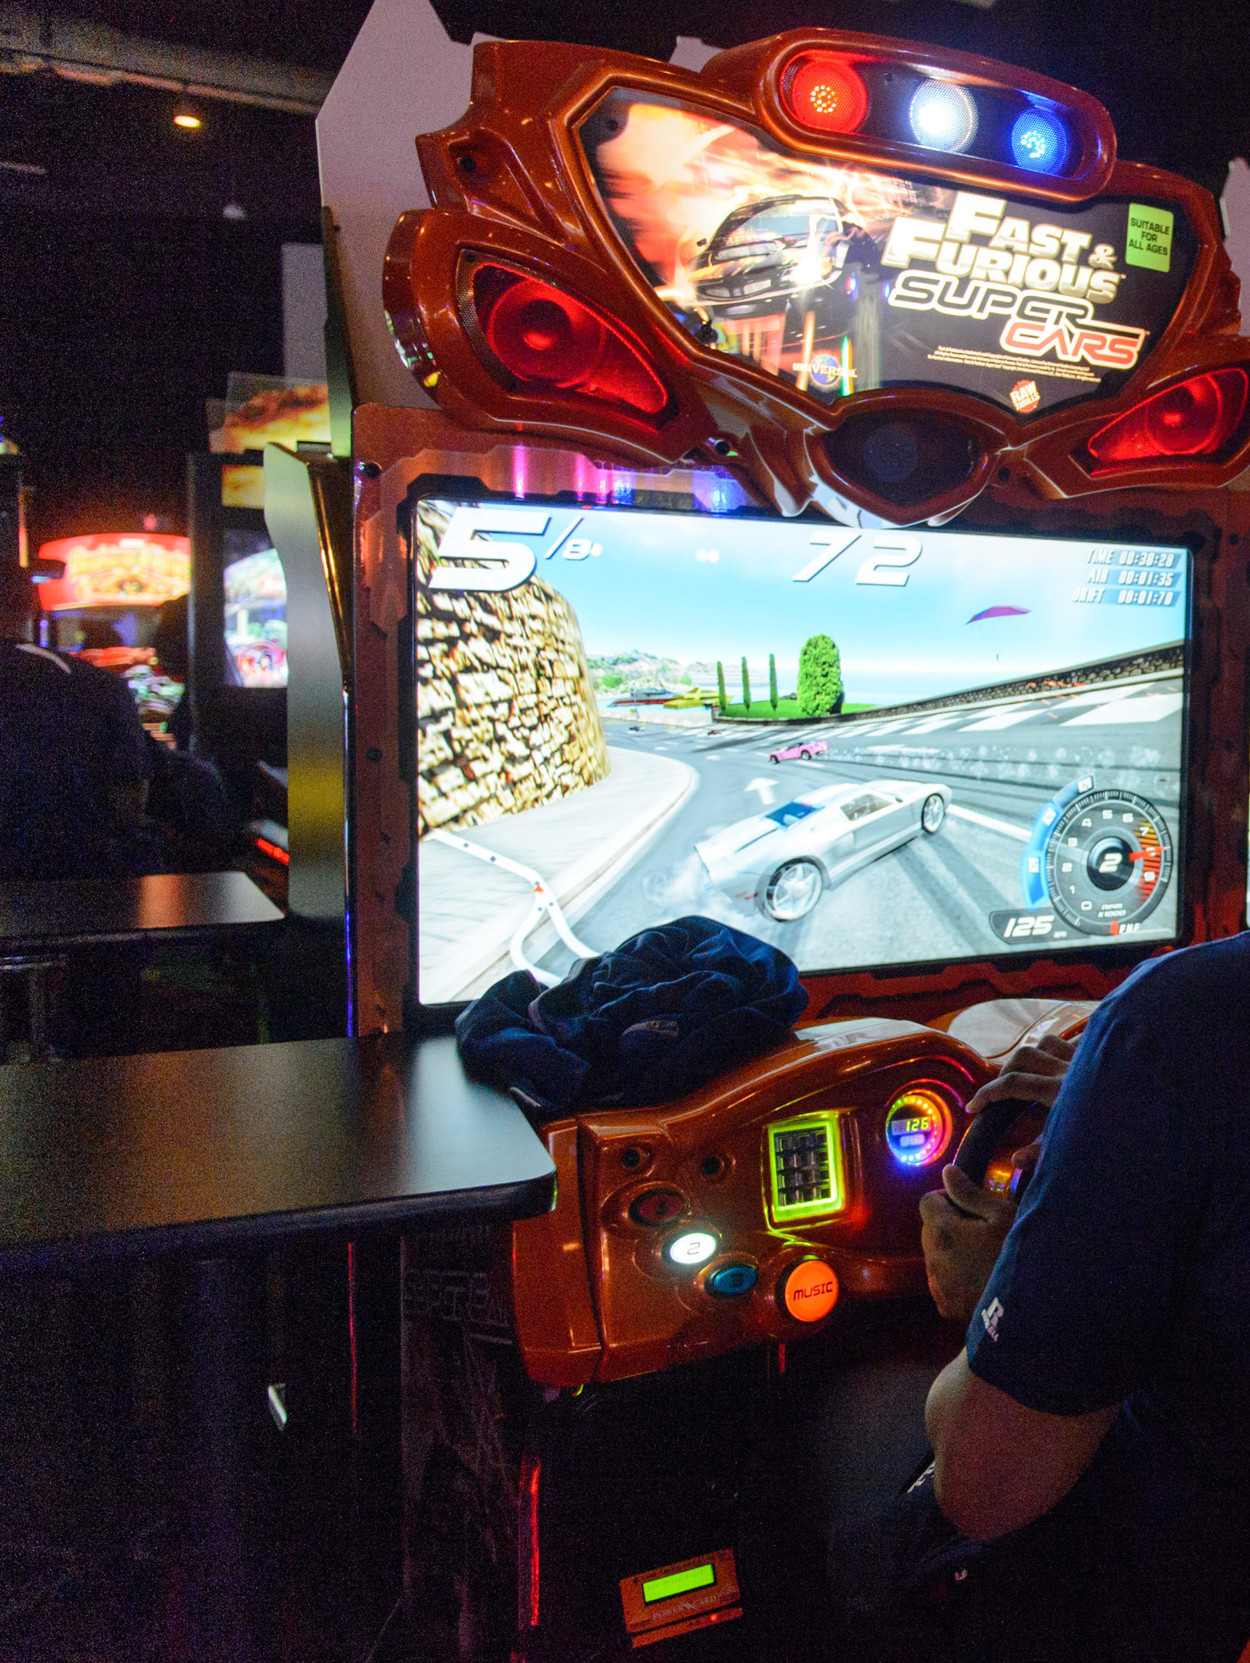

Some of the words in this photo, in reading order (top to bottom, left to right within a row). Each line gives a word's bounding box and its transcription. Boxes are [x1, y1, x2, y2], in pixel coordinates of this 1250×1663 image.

[944, 190, 1093, 263] FAST
[1088, 244, 1118, 270] &
[1130, 217, 1170, 236] SUITABLE
[1141, 231, 1159, 243] FOR
[1128, 238, 1145, 252] ALL
[1146, 242, 1169, 257] AGES
[881, 216, 1122, 304] FURIOUS
[888, 270, 1142, 336] SUPER
[1001, 322, 1141, 369] CARS
[1010, 381, 1037, 403] RAW
[1099, 852, 1123, 873] 2
[1004, 915, 1055, 938] 125
[906, 1117, 929, 1132] 126
[687, 1241, 701, 1256] 2
[793, 1281, 834, 1301] MUSIC
